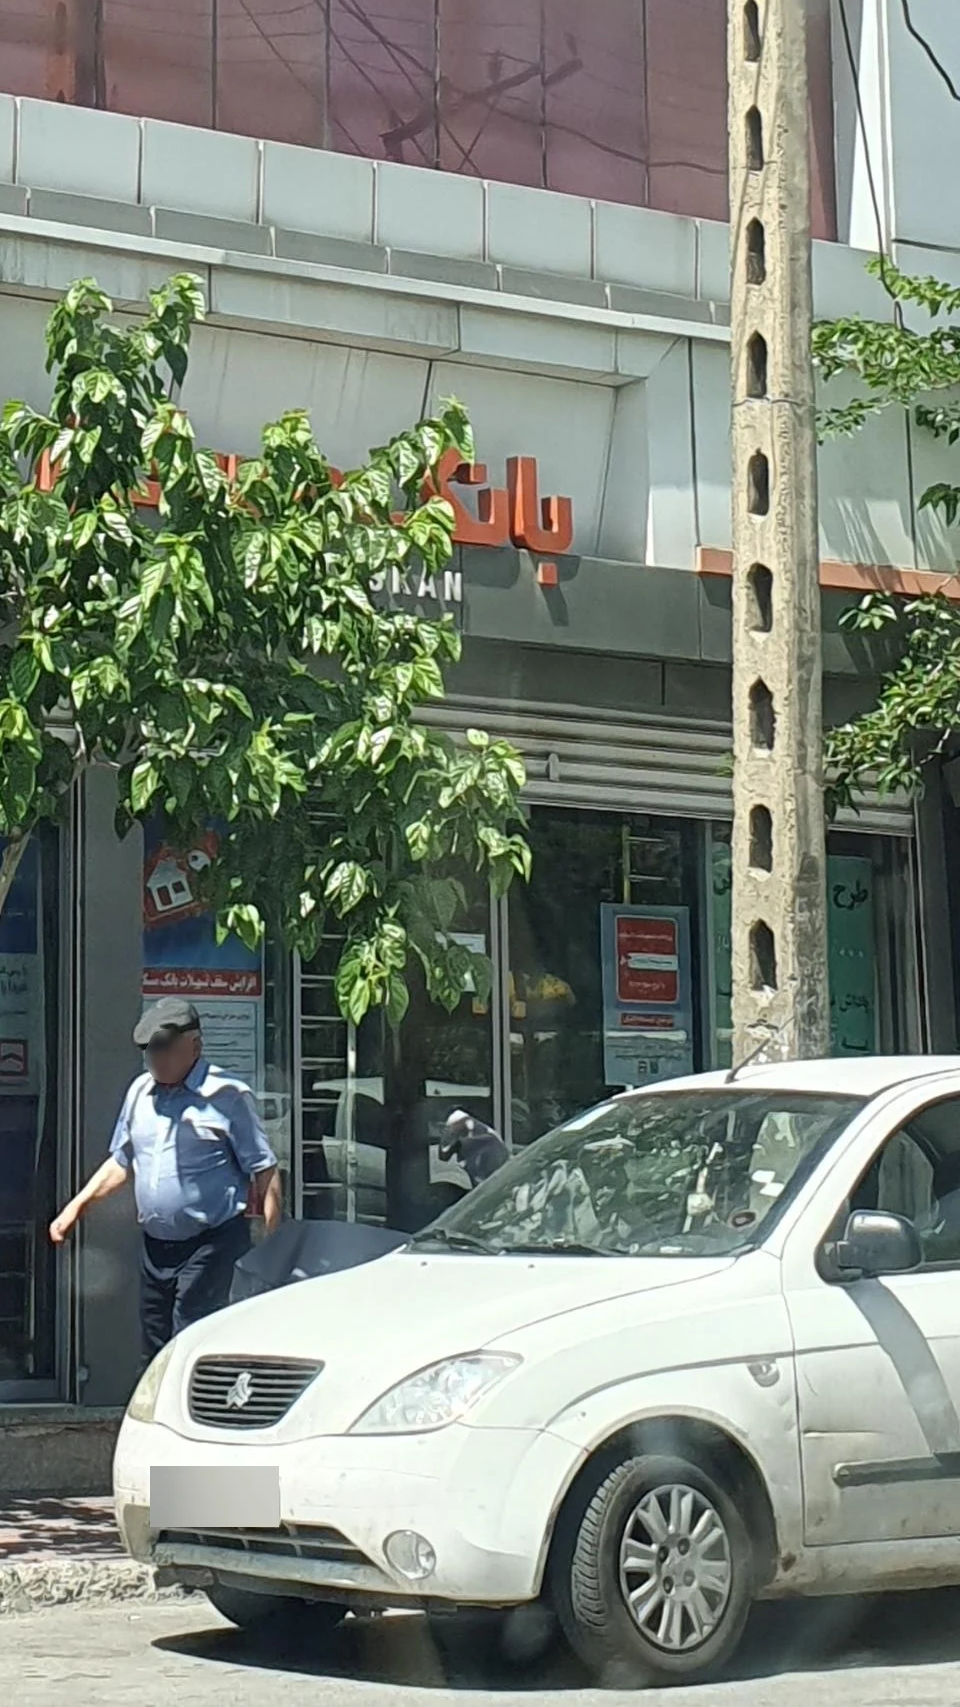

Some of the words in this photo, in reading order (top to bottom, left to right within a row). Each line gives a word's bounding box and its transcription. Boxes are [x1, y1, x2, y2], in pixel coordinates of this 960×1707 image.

[380, 446, 575, 587] بانک
[367, 563, 463, 603] SKAN
[832, 878, 870, 911] طرح
